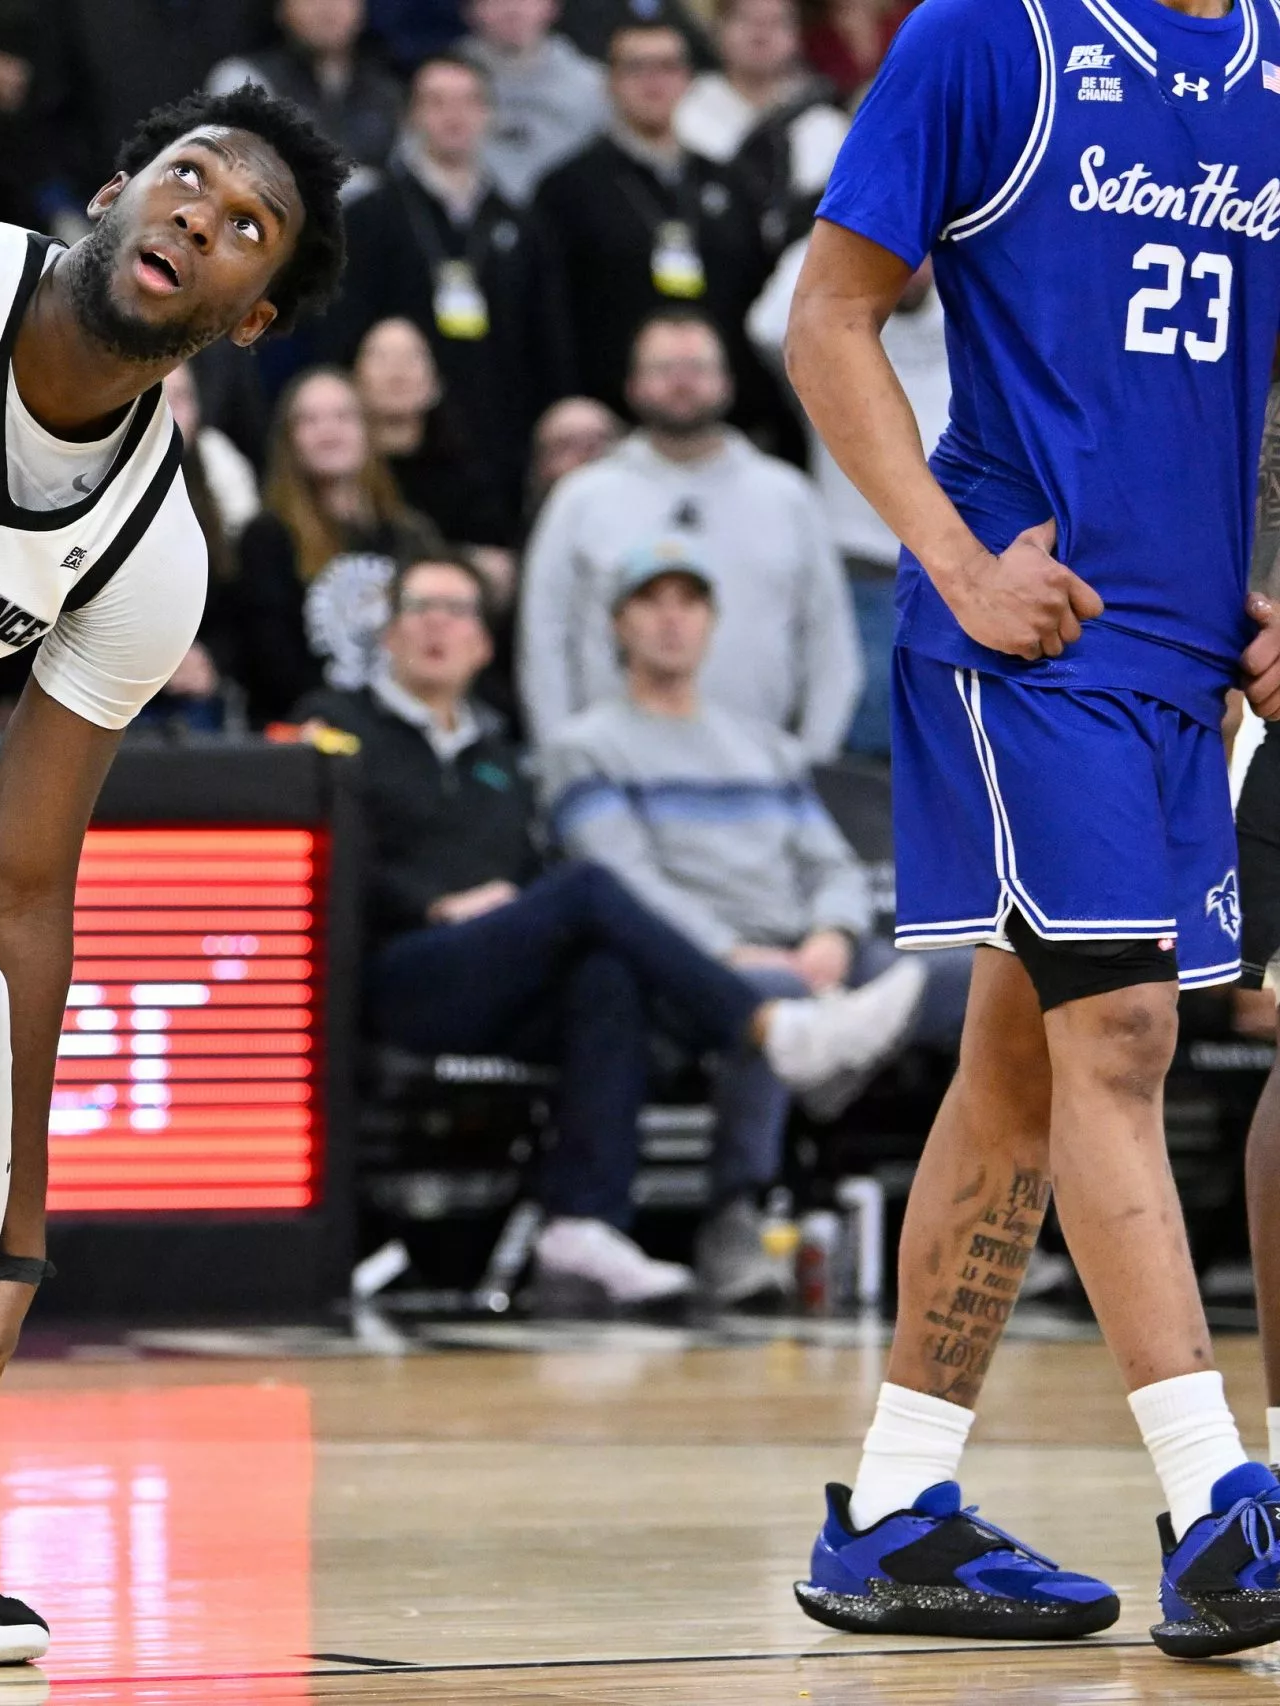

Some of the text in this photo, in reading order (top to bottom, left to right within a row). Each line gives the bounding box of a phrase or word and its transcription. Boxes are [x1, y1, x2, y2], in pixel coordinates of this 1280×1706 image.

[1070, 44, 1105, 57] BIG
[1067, 54, 1115, 68] EAST
[1081, 76, 1121, 90] BE THE
[1077, 88, 1124, 102] CHANGE
[1070, 144, 1280, 242] Seton Hall
[1124, 242, 1233, 363] 23
